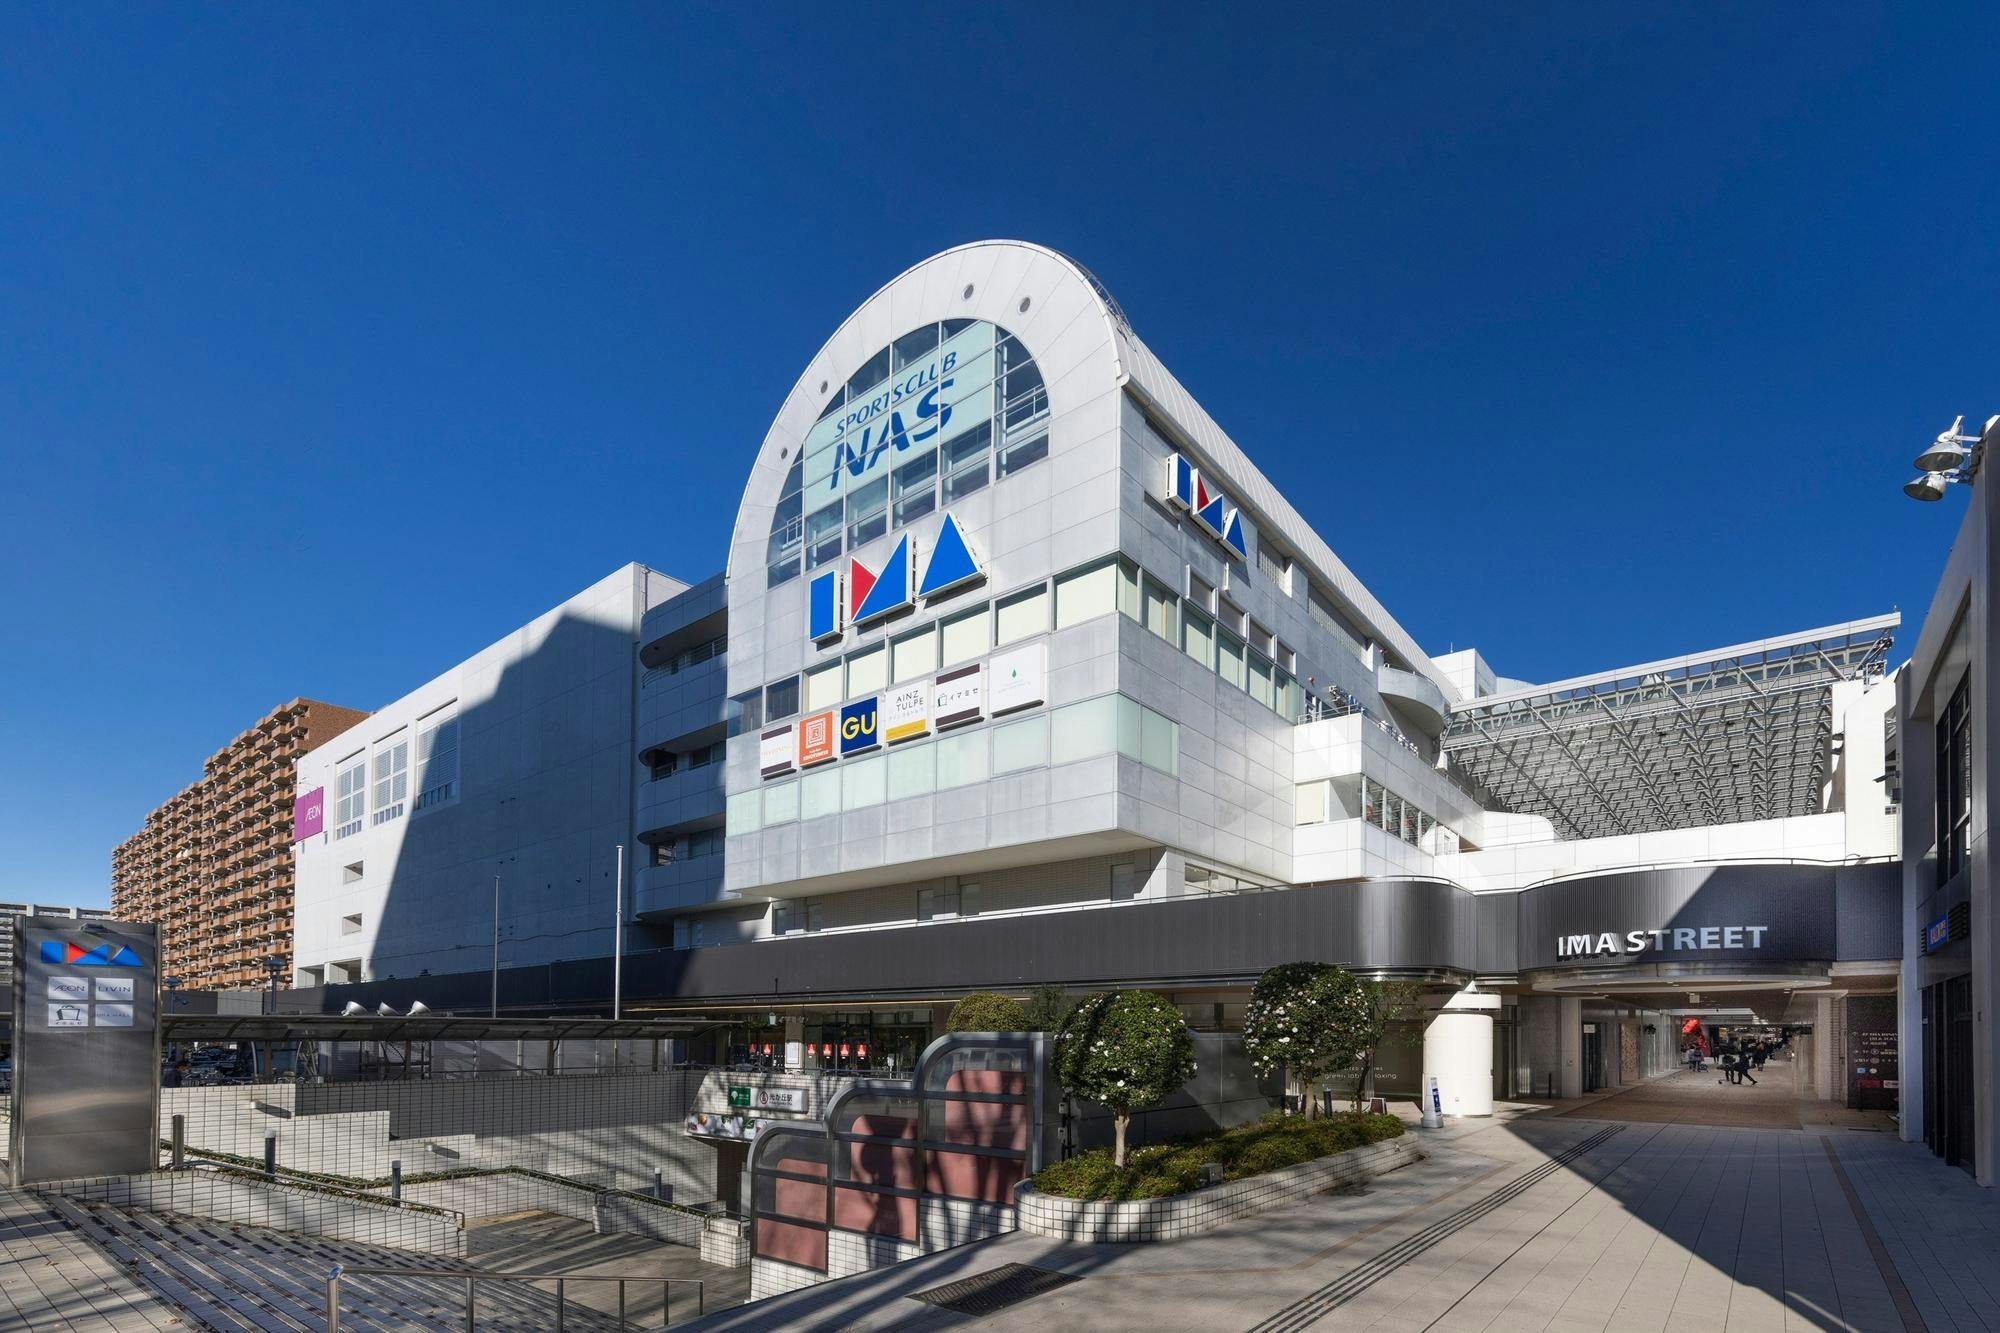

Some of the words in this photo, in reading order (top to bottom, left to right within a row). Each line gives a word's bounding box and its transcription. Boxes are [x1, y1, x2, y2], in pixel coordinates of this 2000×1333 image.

[829, 379, 955, 490] NAS
[896, 690, 919, 704] AINZ
[896, 697, 924, 711] TULPE
[842, 711, 876, 740] GU
[1558, 932, 1617, 956] IMA
[1626, 926, 1768, 952] STREET
